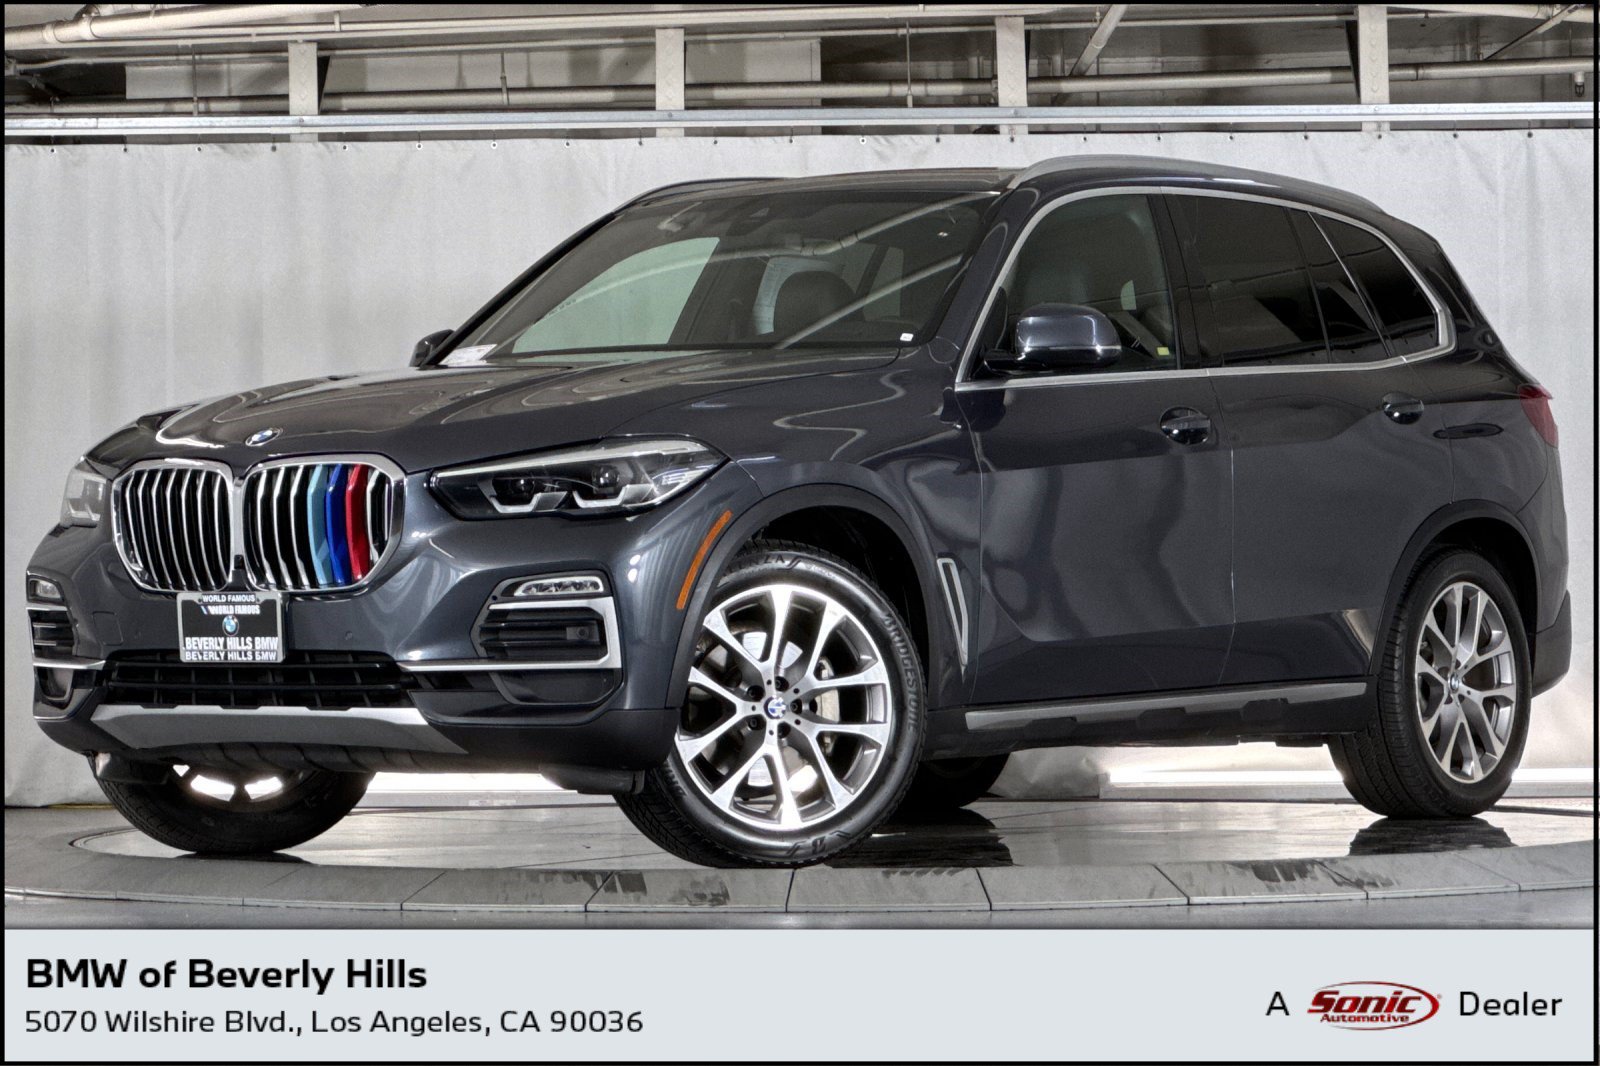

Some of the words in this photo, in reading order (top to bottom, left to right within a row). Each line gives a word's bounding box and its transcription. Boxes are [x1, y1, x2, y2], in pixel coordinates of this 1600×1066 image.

[202, 594, 226, 603] WORLD
[227, 594, 255, 603] FAMOUS
[208, 605, 234, 615] WORLD
[234, 605, 260, 615] FAMOUS
[185, 637, 224, 650] BEVERLY
[226, 637, 252, 650] HILLS
[254, 637, 279, 650] BMW
[185, 651, 225, 661] BEVERLY
[227, 651, 252, 661] HILLS
[255, 651, 277, 661] BMW
[883, 613, 919, 733] BRIDGESTONE
